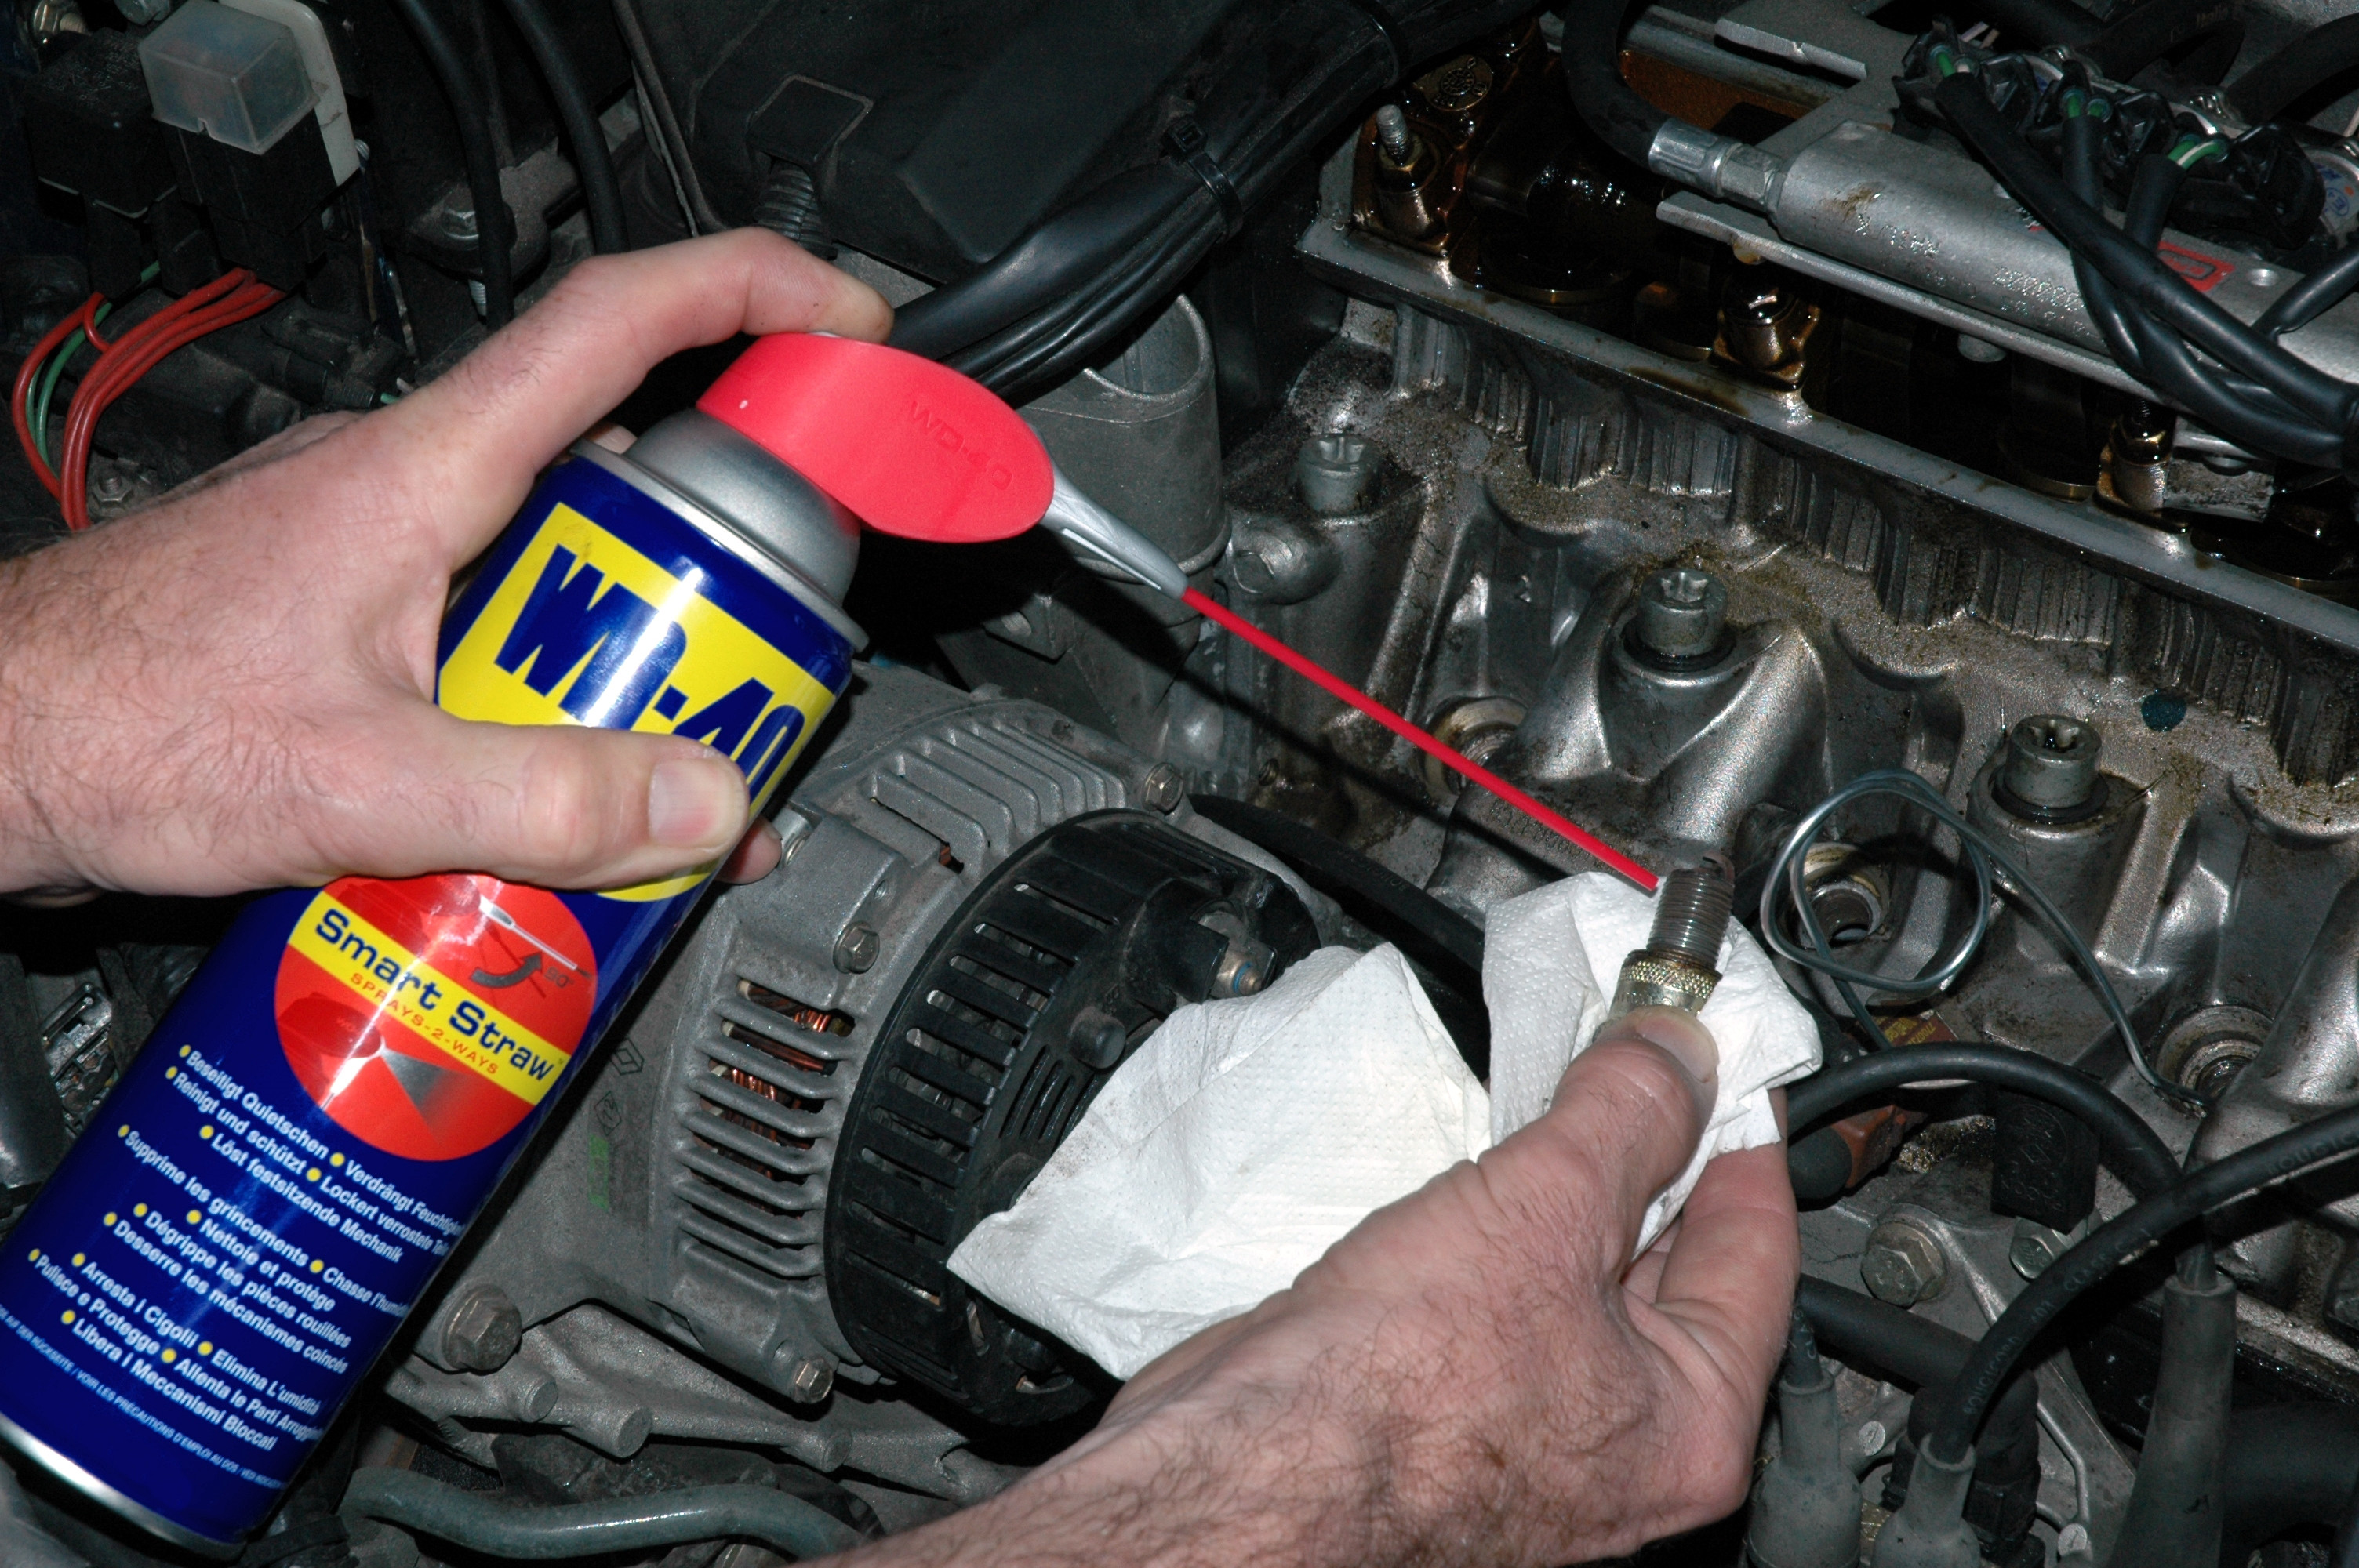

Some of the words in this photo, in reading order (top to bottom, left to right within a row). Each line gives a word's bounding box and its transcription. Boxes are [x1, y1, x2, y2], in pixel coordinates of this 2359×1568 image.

[494, 543, 805, 808] WD-40
[315, 908, 443, 1011] Smart
[449, 1000, 554, 1082] Straw
[173, 1072, 220, 1114] Reinigt
[216, 1108, 250, 1135] und
[246, 1130, 307, 1175] schützt
[320, 1175, 380, 1221] Lockert
[377, 1213, 433, 1250] verrostete
[186, 1051, 244, 1100] Beseitigt
[242, 1092, 329, 1160] Quietschen
[345, 1160, 414, 1212] Verdrängt
[211, 1133, 249, 1167] Löst
[246, 1158, 341, 1227] festsitzende
[339, 1218, 404, 1263] Mechanik
[125, 1131, 186, 1184] Supprime
[184, 1176, 211, 1203] les
[208, 1197, 309, 1267] grincements
[322, 1267, 373, 1302] Chasse
[144, 1210, 217, 1269] Dégrippe
[216, 1261, 245, 1287] les
[241, 1281, 297, 1319] pièces
[295, 1312, 352, 1348] rouillées
[199, 1218, 259, 1265] Nettoie
[259, 1261, 279, 1279] et
[274, 1271, 336, 1312] protège
[35, 1254, 79, 1298] Pulisce
[77, 1292, 91, 1306] e
[88, 1298, 161, 1355] Protegge
[173, 1357, 231, 1399] Allenta
[229, 1389, 247, 1408] le
[245, 1398, 282, 1425] Parti
[81, 1261, 136, 1308] Arresta
[144, 1305, 200, 1349] Cigolii
[210, 1348, 268, 1391] Elimina
[113, 1219, 183, 1276] Desserre
[181, 1268, 209, 1294] les
[209, 1289, 304, 1353] mécanismes
[303, 1345, 349, 1374] coincés
[72, 1318, 123, 1362] Libera
[129, 1358, 227, 1425] Meccanismi
[222, 1414, 278, 1451] Bloccati
[96, 1385, 116, 1402] LES
